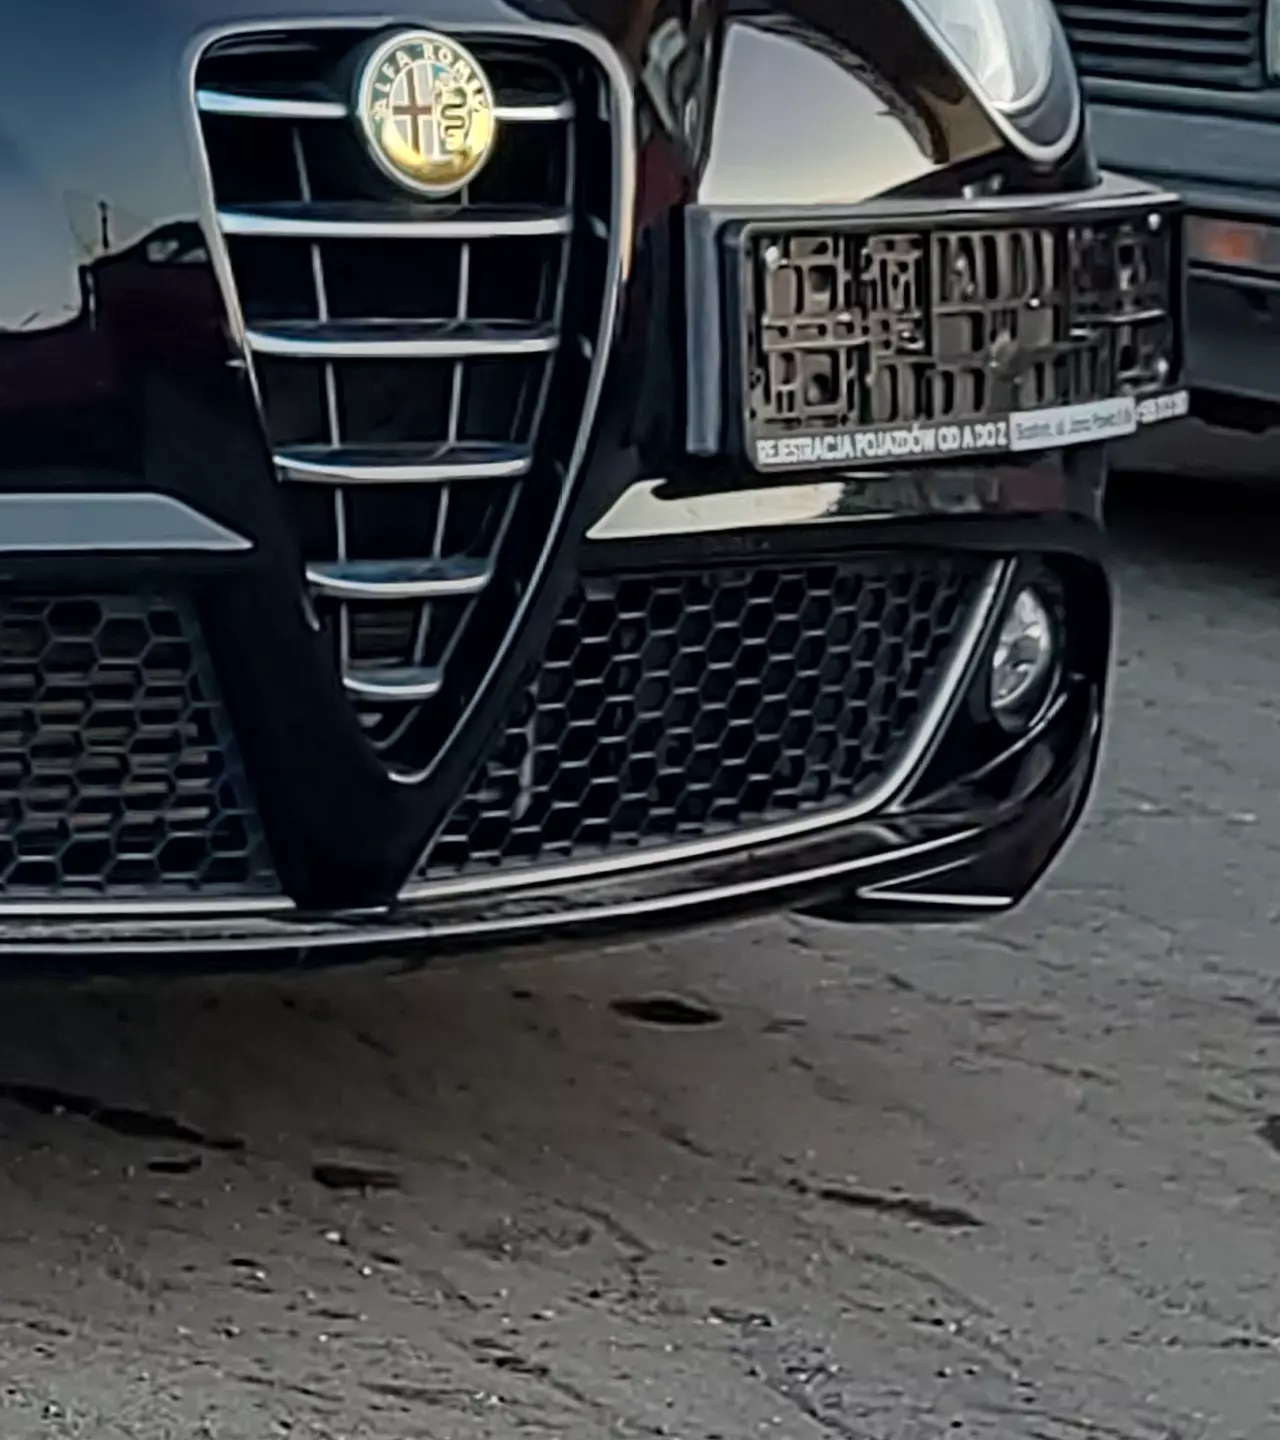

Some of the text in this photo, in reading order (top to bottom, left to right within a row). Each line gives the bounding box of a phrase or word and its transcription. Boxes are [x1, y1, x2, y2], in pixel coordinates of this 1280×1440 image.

[373, 50, 413, 118] ALFA
[756, 432, 855, 464] REJESTRACJA
[854, 423, 936, 458] POJAZDÓW
[938, 425, 960, 452] OD
[962, 425, 976, 449] A
[976, 423, 996, 448] DO
[996, 421, 1008, 446] Z
